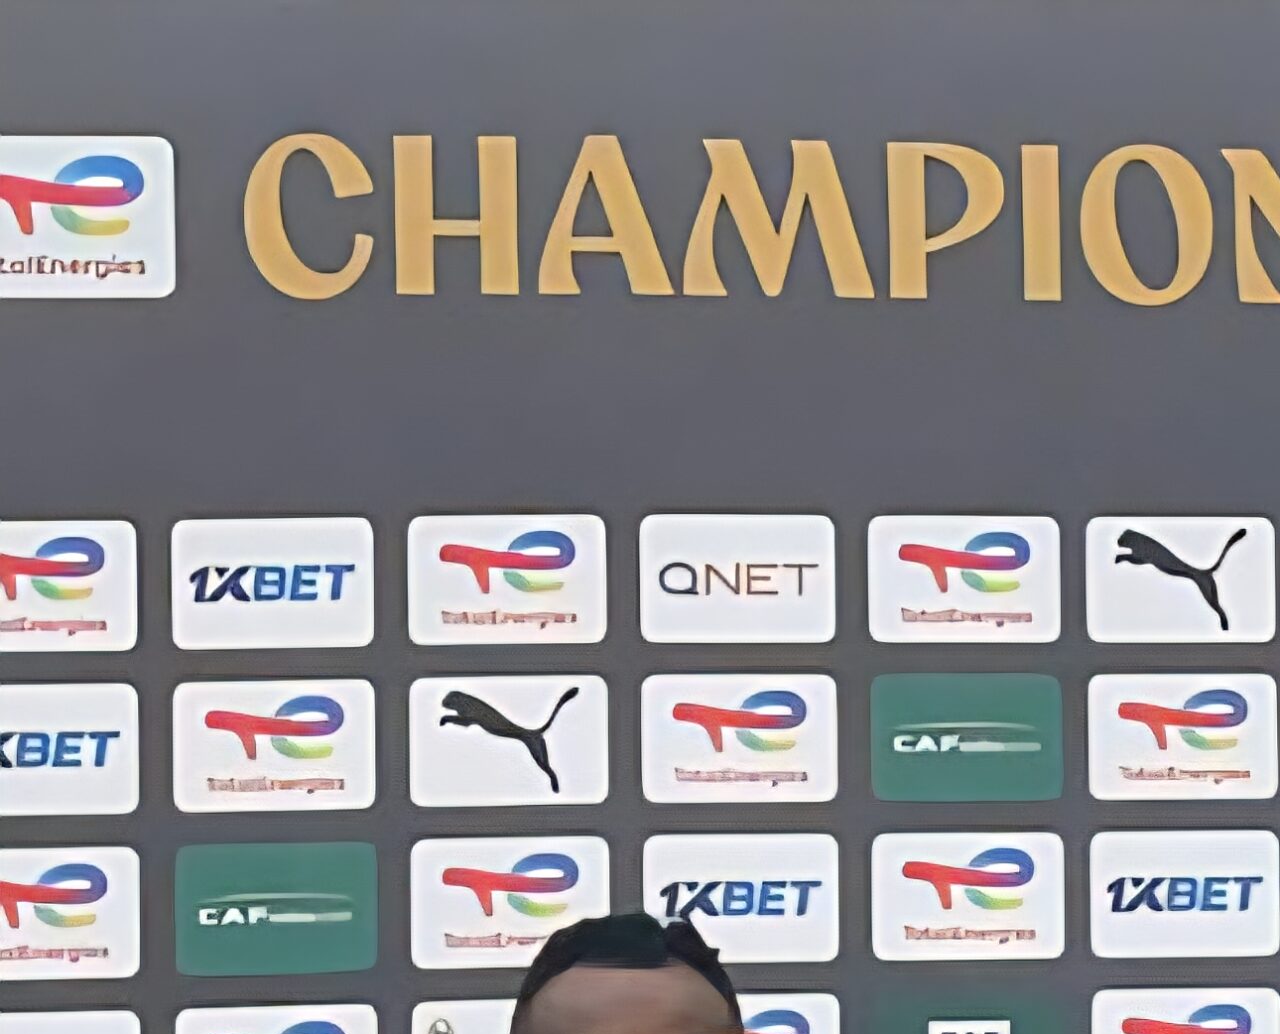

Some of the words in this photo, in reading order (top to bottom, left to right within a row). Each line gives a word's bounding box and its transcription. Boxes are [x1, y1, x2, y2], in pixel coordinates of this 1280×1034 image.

[189, 564, 355, 603] 1XBET
[659, 562, 818, 595] QNET
[660, 880, 823, 916] 1XBET
[1107, 876, 1263, 912] 1XBET
